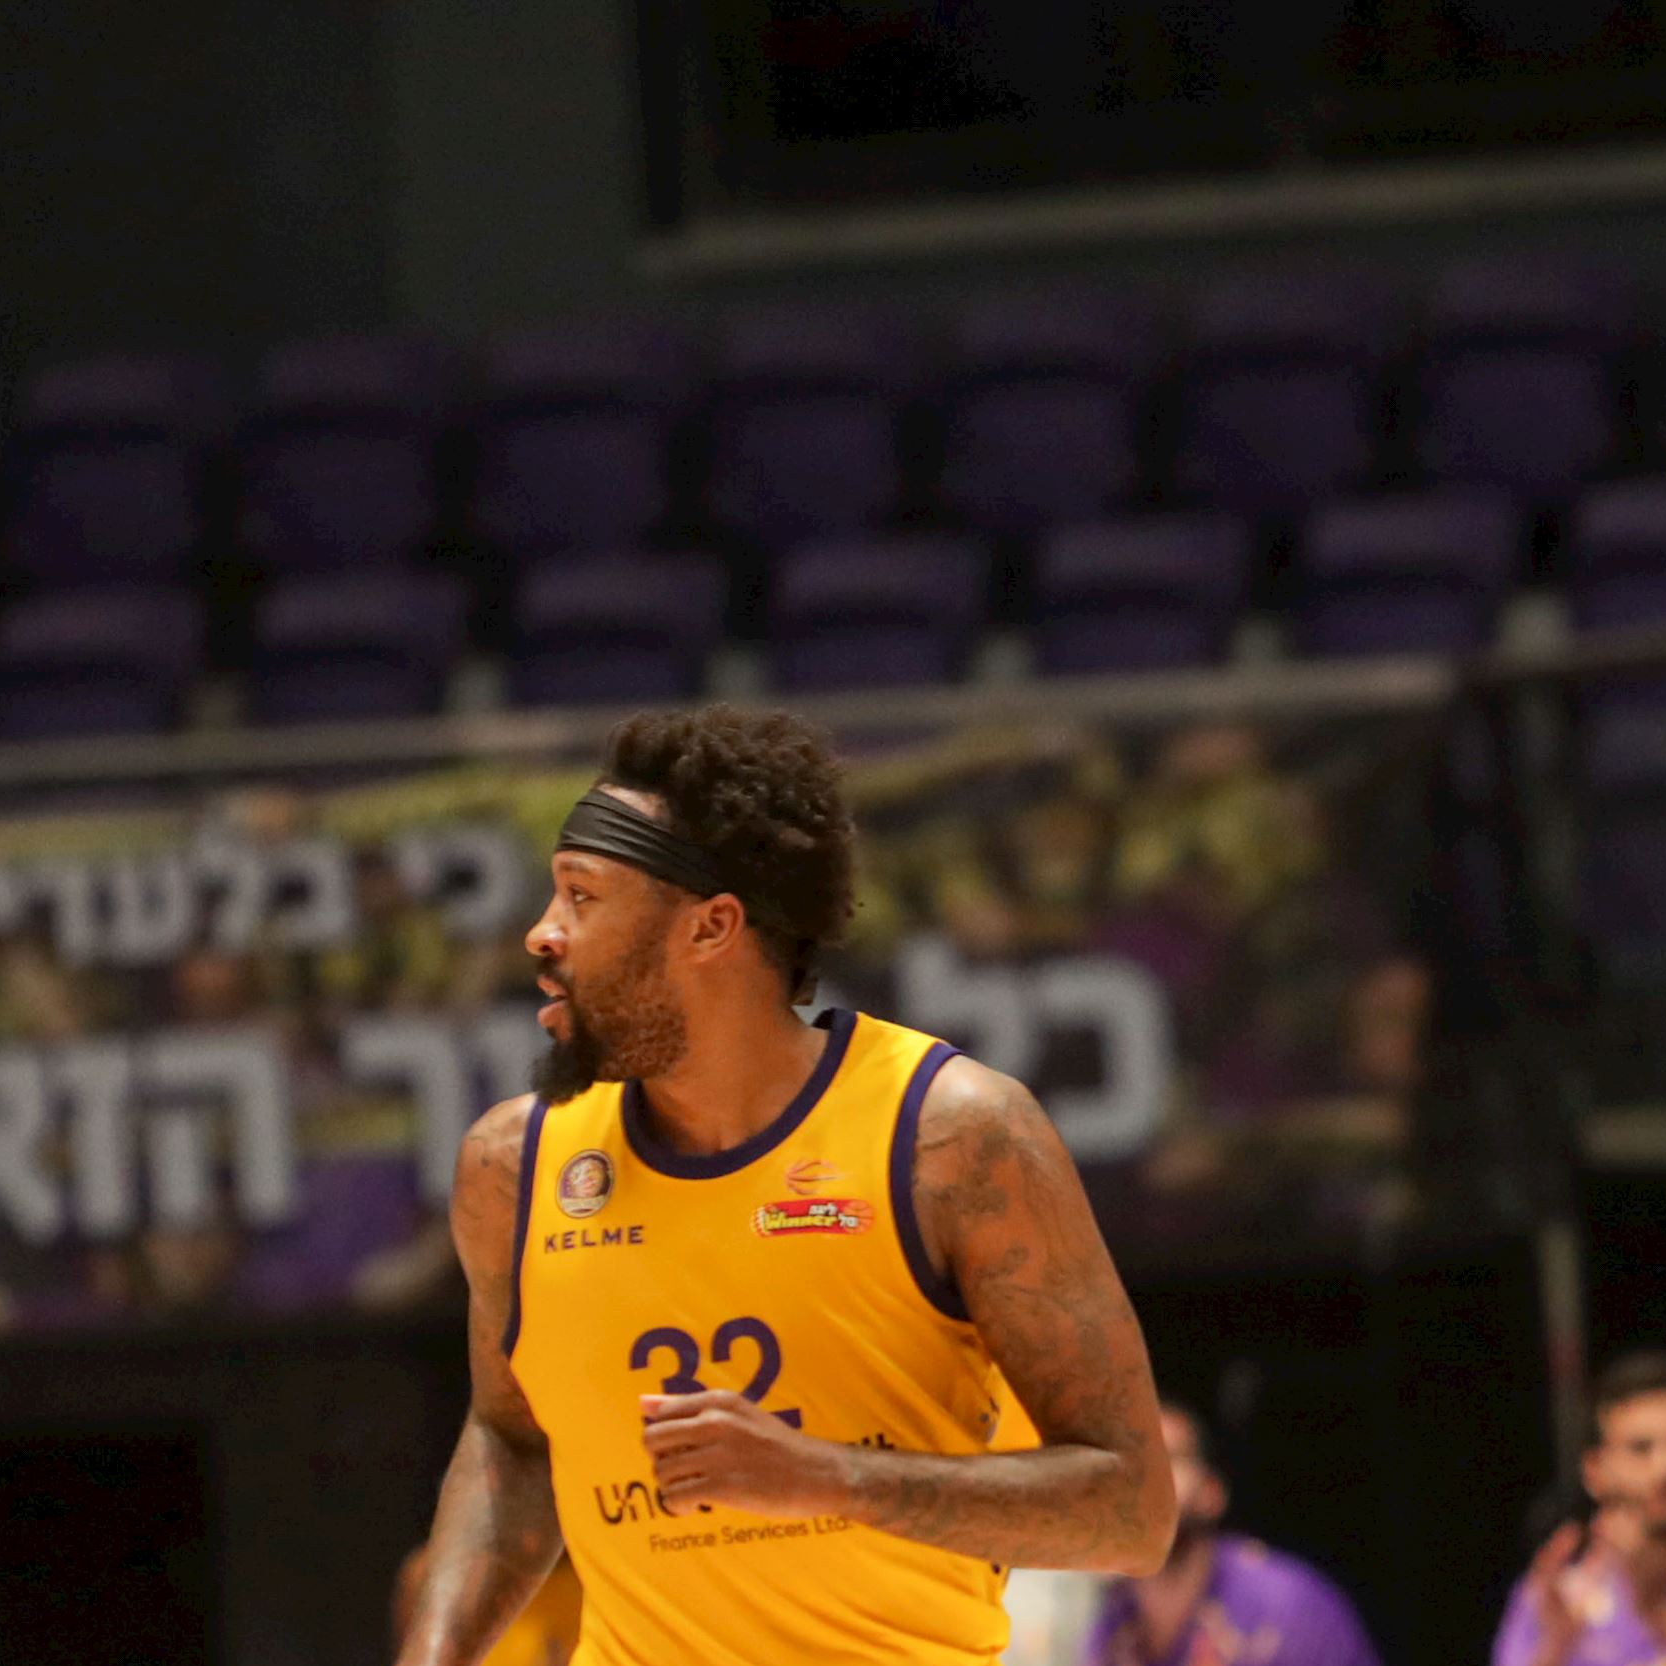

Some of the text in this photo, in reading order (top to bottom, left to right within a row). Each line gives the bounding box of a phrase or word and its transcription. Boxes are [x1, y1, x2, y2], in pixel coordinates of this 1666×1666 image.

[544, 1224, 645, 1254] KELME
[629, 1316, 802, 1430] 32
[720, 1522, 809, 1546] Services
